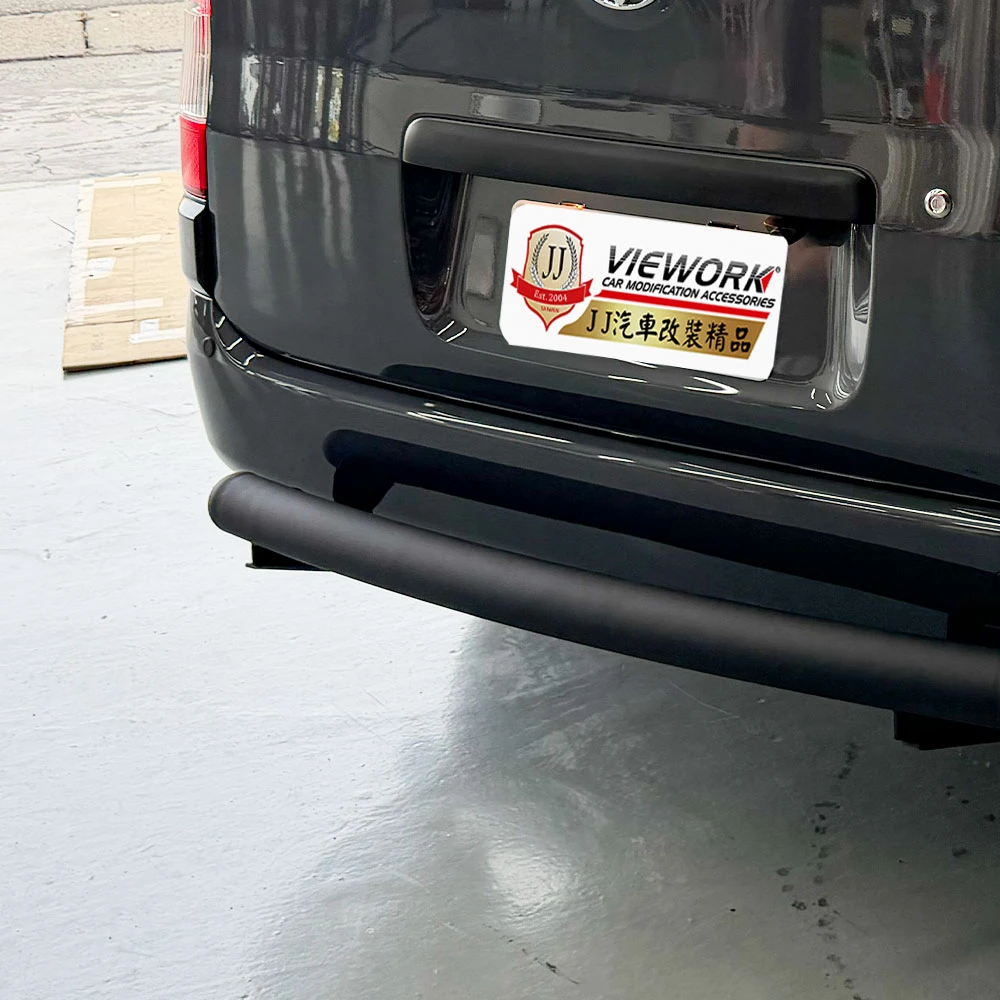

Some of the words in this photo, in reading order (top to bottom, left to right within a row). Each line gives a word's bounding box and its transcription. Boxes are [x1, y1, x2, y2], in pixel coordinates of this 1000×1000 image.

[542, 245, 568, 281] JJ
[608, 245, 775, 294] VIEWORK
[601, 276, 624, 290] CAR
[625, 280, 700, 299] MODIFICATION
[700, 291, 777, 310] ACCESSORIES
[586, 308, 752, 354] JJ汽車改裝精品
